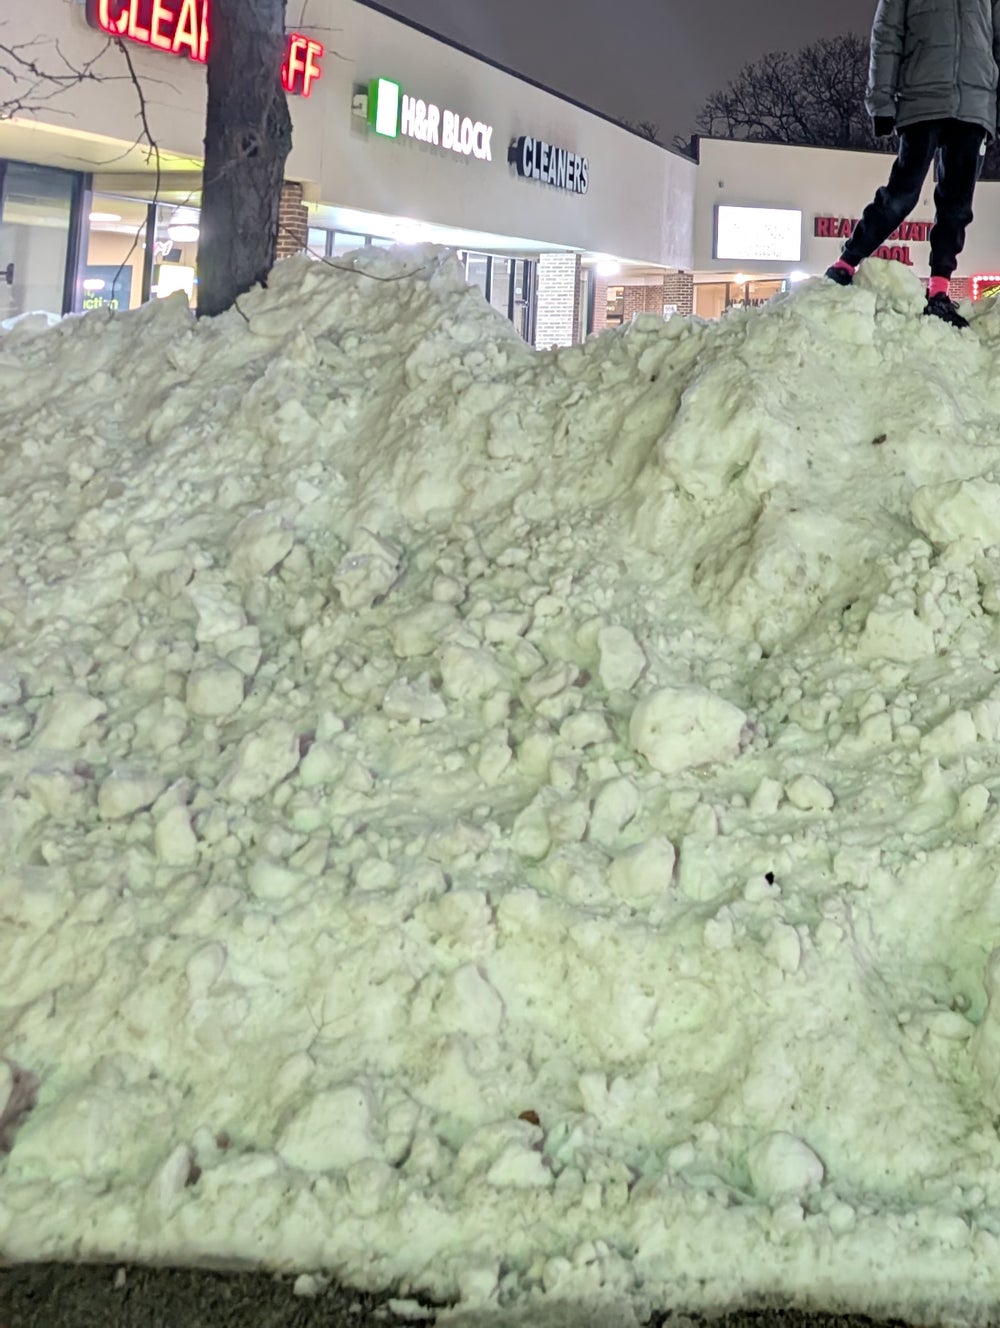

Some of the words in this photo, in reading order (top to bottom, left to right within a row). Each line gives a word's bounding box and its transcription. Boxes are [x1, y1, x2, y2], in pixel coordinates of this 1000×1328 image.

[401, 95, 440, 145] H&R
[442, 109, 492, 162] BLOCK
[521, 135, 589, 194] CLEANERS
